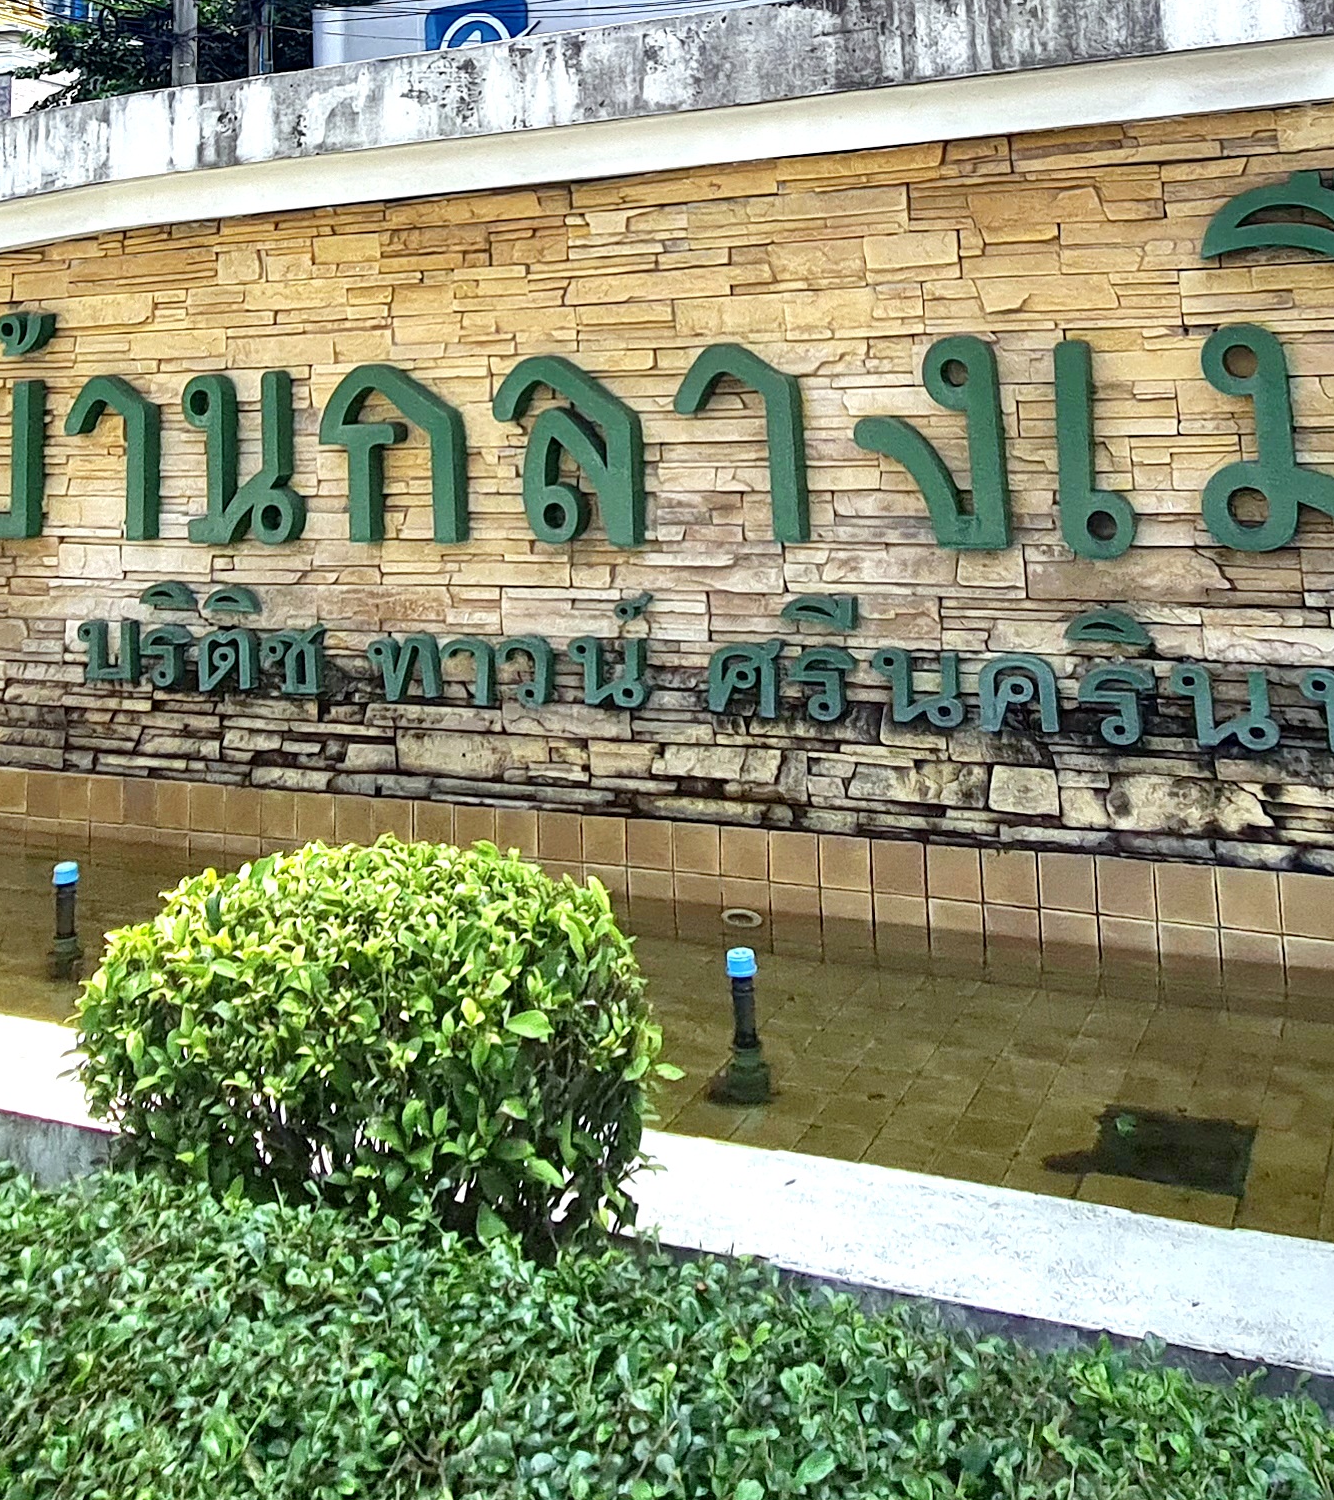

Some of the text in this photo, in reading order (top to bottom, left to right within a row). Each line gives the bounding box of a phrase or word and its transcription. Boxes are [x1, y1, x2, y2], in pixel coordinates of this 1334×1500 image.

[77, 580, 327, 695] บริติช
[366, 591, 652, 710] ทาวน์
